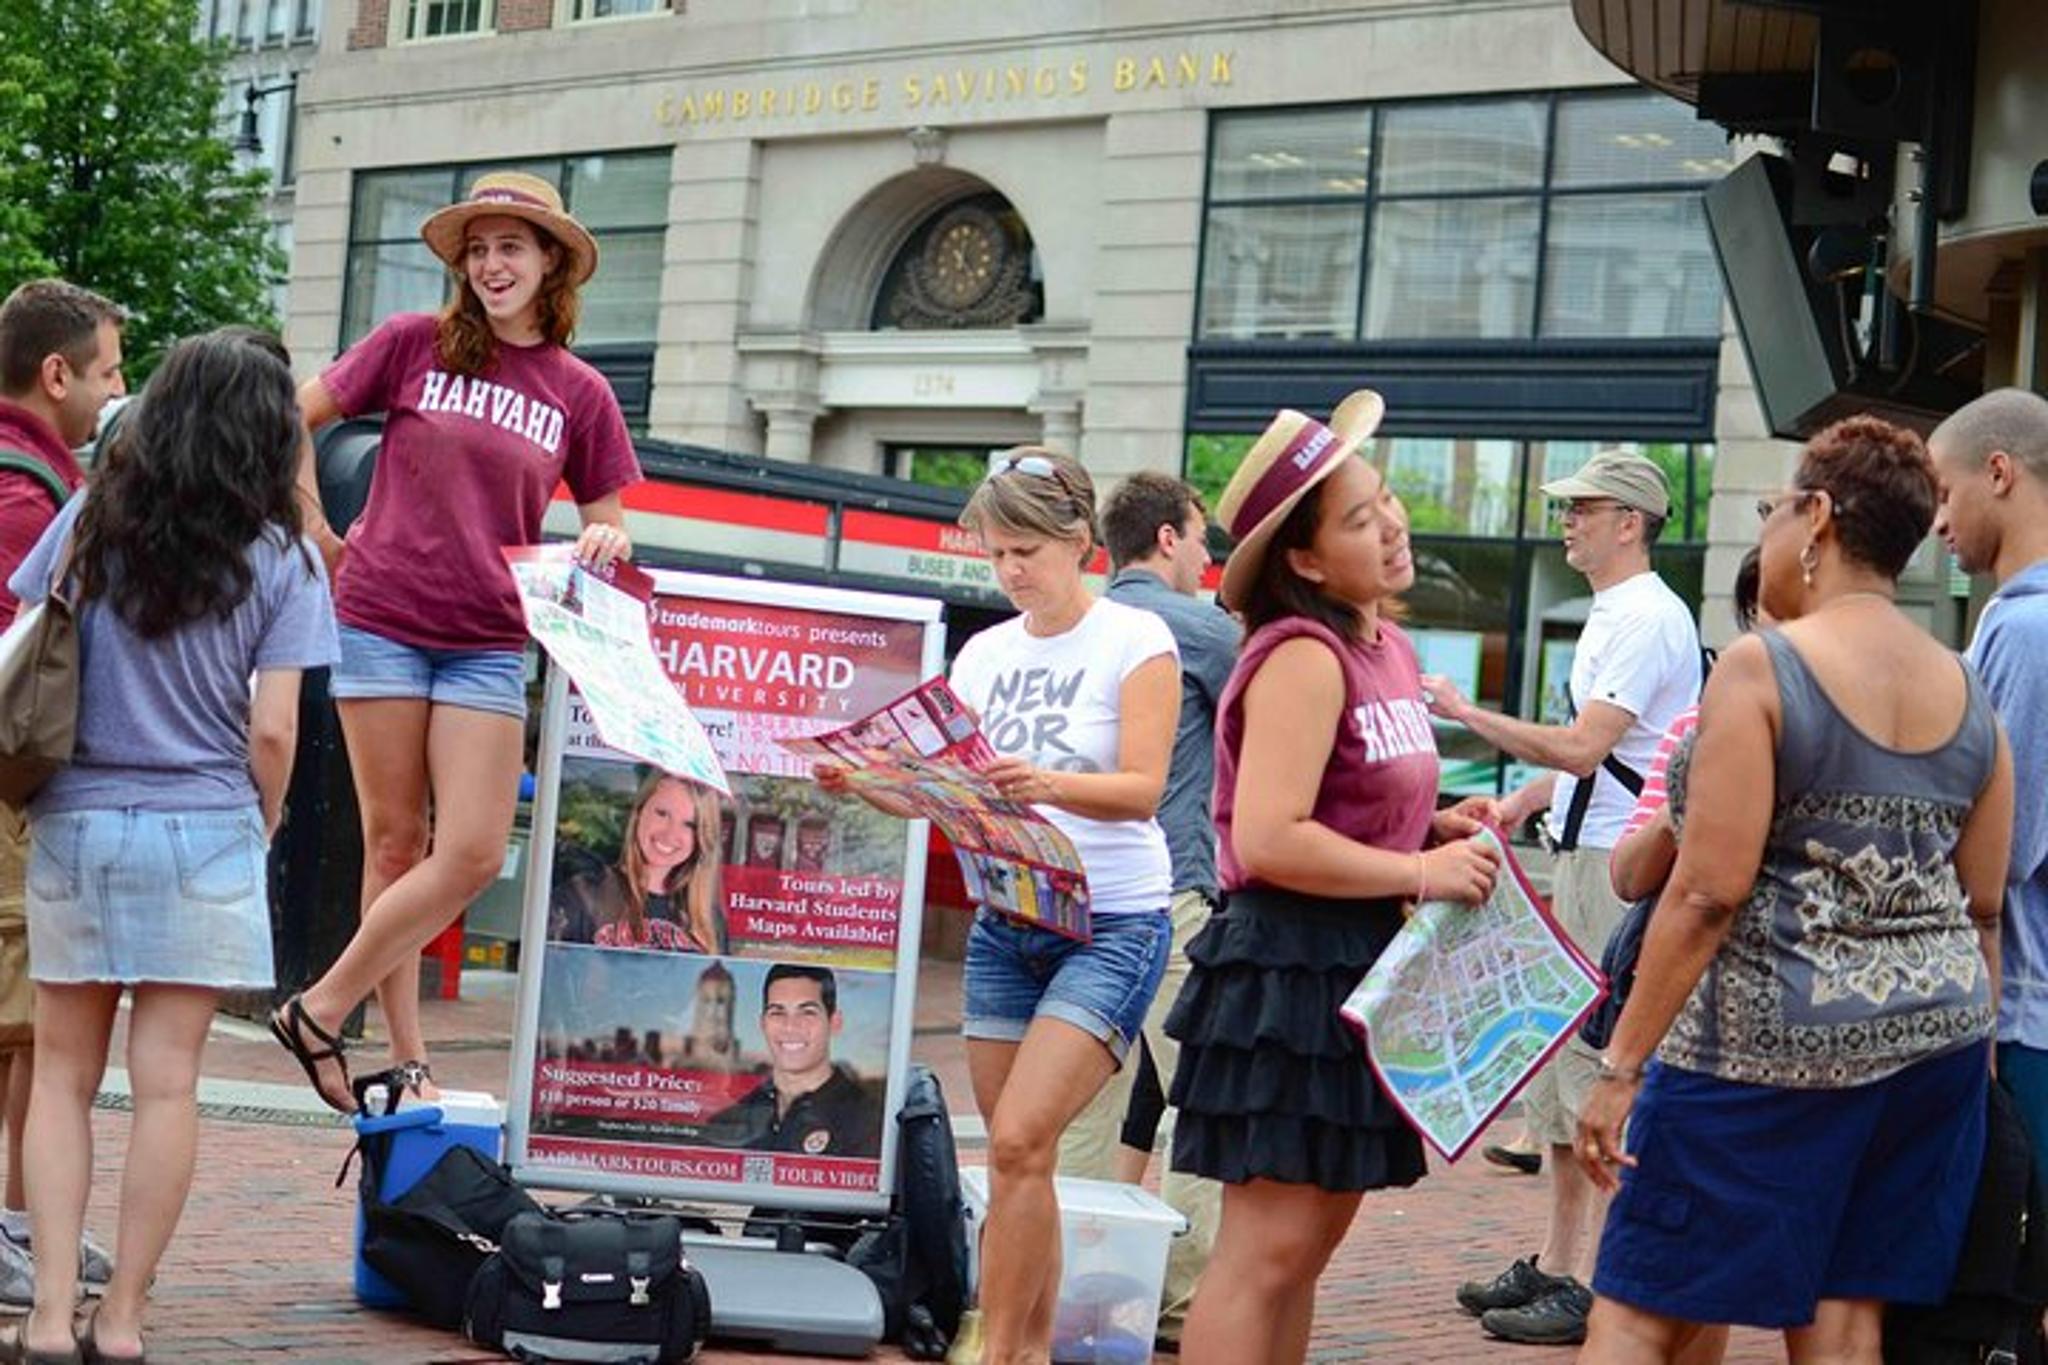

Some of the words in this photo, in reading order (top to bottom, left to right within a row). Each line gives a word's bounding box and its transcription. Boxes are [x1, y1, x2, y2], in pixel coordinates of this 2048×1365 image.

[655, 76, 881, 127] CAMBRIDGE
[905, 59, 1089, 106] SAVINGS
[1113, 50, 1235, 93] BANK
[907, 553, 955, 578] BUSES
[961, 560, 992, 581] AND
[809, 625, 887, 650] presents
[652, 637, 856, 691] HARVARD
[674, 680, 851, 713] NIVERSITY
[983, 667, 1085, 713] NEW
[780, 874, 834, 895] Tours
[840, 879, 870, 898] led
[875, 880, 899, 905] by
[729, 892, 808, 916] Harvard
[812, 899, 897, 923] Students
[747, 916, 798, 939] Maps
[801, 921, 895, 945] Available!
[541, 1063, 641, 1089] Suggested
[566, 1091, 613, 1110] person
[613, 1097, 630, 1109] or
[530, 1147, 738, 1180] RADEMARKTOURS.COM
[777, 1165, 826, 1185] TOUR
